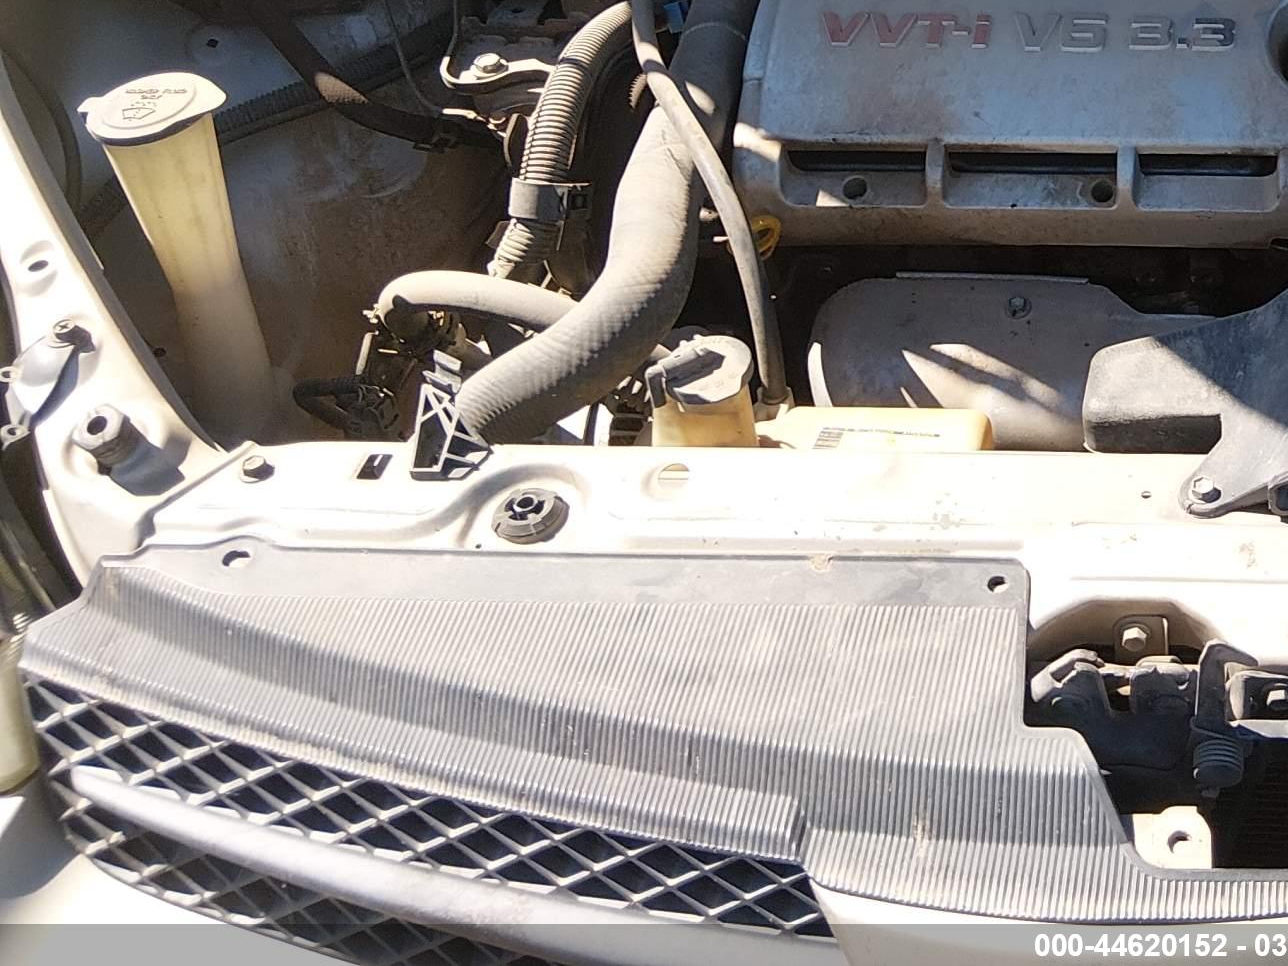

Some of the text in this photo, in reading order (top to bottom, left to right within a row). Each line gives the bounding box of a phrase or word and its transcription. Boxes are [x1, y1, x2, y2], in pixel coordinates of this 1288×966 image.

[823, 11, 1236, 52] VVT-i V6 3.3
